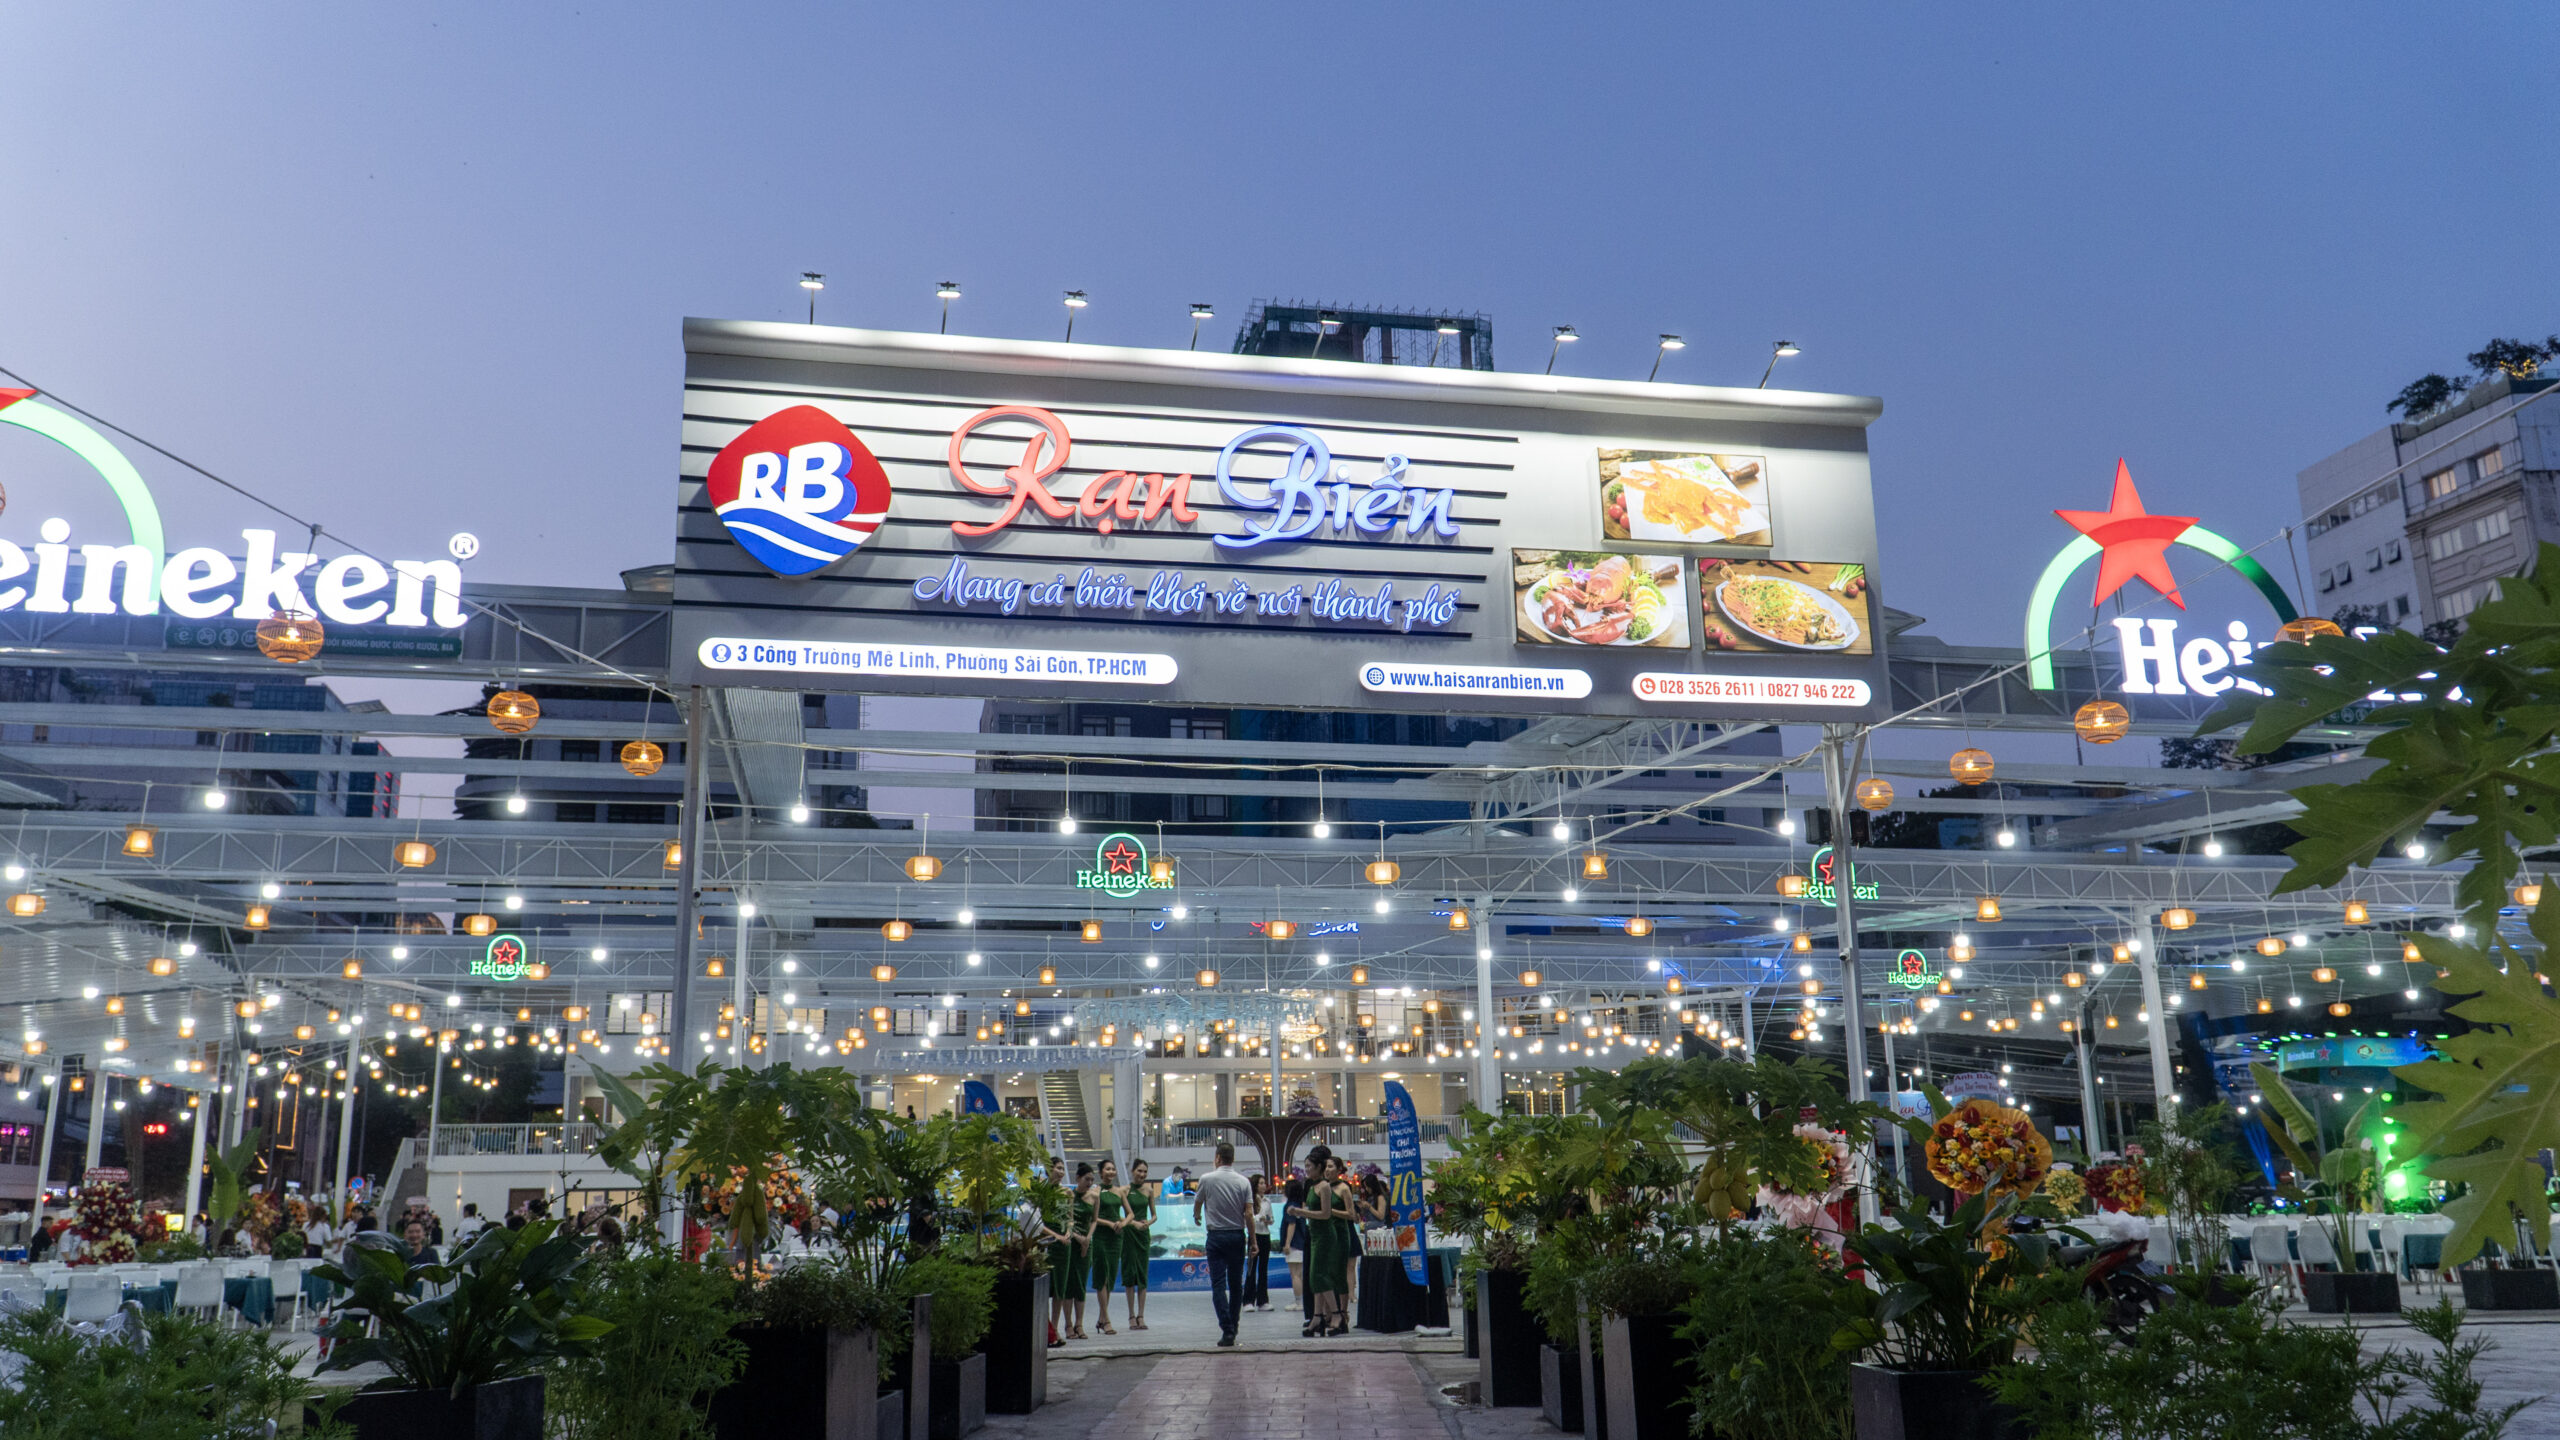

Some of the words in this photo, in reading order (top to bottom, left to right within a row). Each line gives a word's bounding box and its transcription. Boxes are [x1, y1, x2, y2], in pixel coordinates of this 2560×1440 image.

[738, 441, 848, 514] RB
[948, 405, 1198, 536] Rạn
[1212, 425, 1461, 547] Biển
[913, 554, 1024, 616] Mang
[1028, 575, 1065, 606] cả
[1075, 567, 1135, 608] biển
[1145, 571, 1206, 613] khơi
[1215, 577, 1248, 613] về
[1258, 586, 1303, 616] nơi
[1312, 578, 1393, 624] thành
[1403, 583, 1460, 632] phố
[738, 645, 747, 662] 3
[754, 645, 796, 665] Công
[803, 647, 861, 668] Trường
[868, 651, 893, 667] Mê
[900, 651, 940, 671] Linh,
[946, 653, 1008, 674] Phường
[1015, 656, 1041, 673] Sài
[1047, 656, 1082, 674] Gòn,
[1088, 658, 1146, 676] TP.HCM
[1391, 671, 1564, 691] www.haisanranbien.vn
[1660, 680, 1684, 694] 028
[1689, 681, 1721, 695] 3526
[1725, 682, 1754, 696] 2611
[1768, 683, 1798, 697] 0827
[1804, 684, 1827, 698] 946
[1832, 685, 1855, 699] 222
